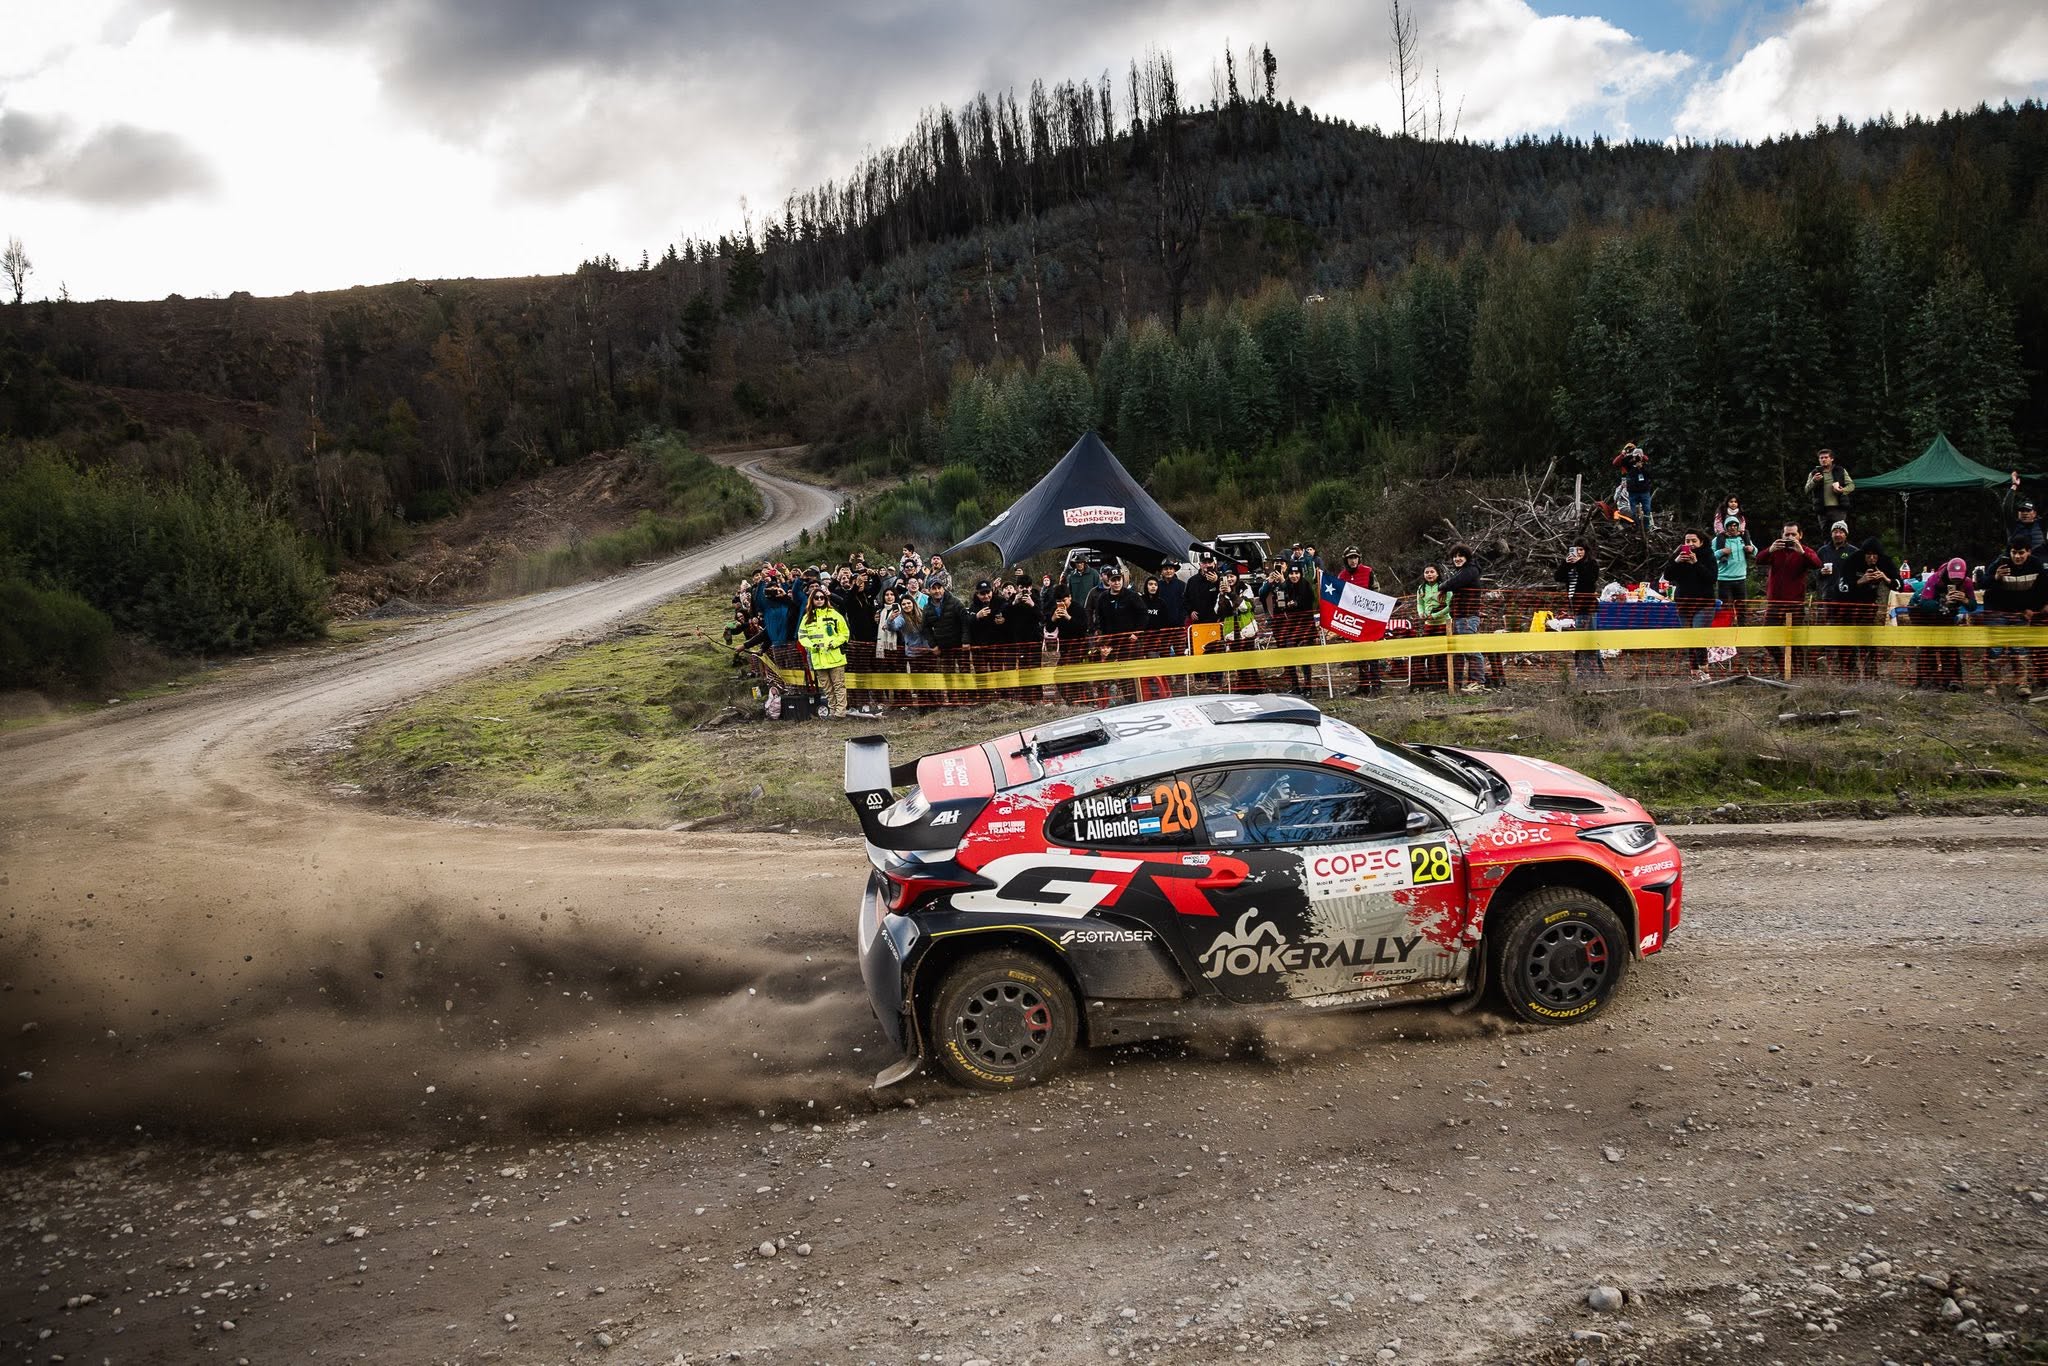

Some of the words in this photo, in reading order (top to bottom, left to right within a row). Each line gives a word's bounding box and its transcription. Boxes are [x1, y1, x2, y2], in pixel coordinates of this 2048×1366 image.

[1066, 509, 1123, 517] Maritano
[1333, 610, 1365, 630] WRC
[1073, 800, 1084, 820] A
[1085, 796, 1128, 818] Heller
[1154, 781, 1198, 834] 28
[988, 826, 1026, 835] TRAINING
[1074, 822, 1084, 842] L
[1086, 816, 1139, 841] Allende
[1491, 827, 1552, 847] COPEC
[1314, 849, 1401, 877] COPEC
[1410, 846, 1451, 882] 28
[1077, 930, 1153, 943] SOTRASER
[1375, 975, 1412, 983] Racing
[1528, 998, 1597, 1017] SCORPION
[948, 1041, 1015, 1083] SCORPION
